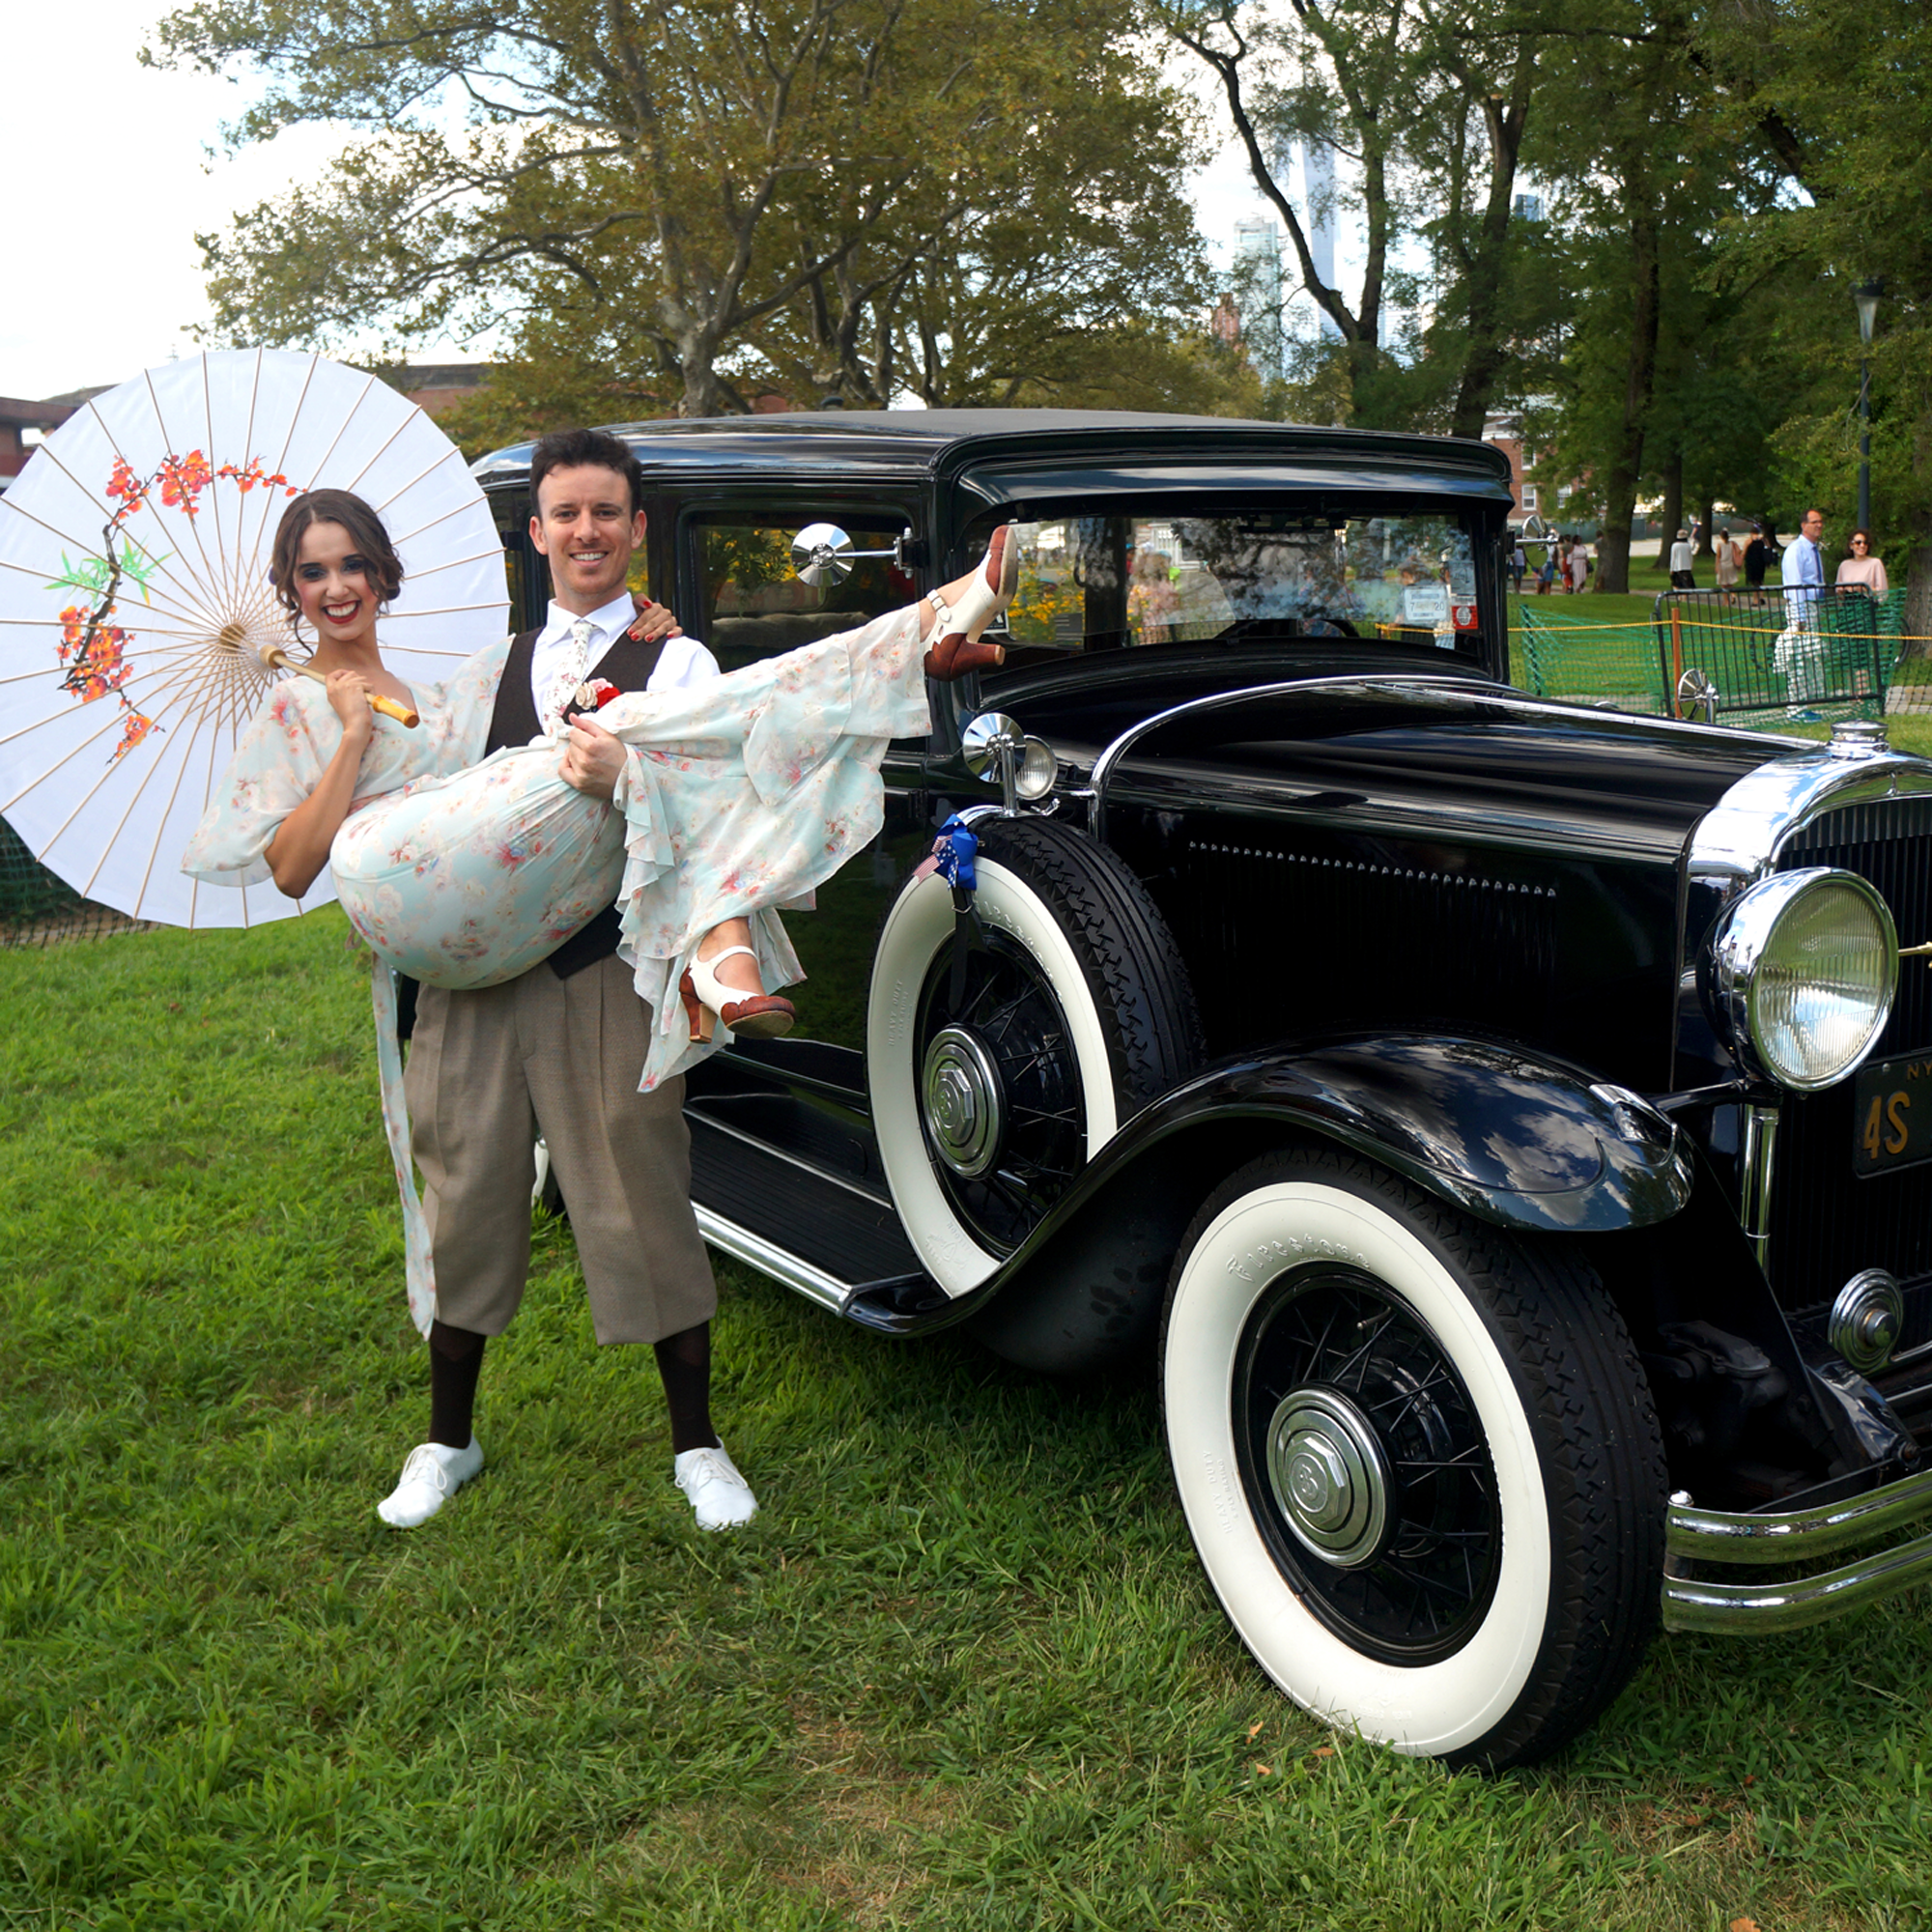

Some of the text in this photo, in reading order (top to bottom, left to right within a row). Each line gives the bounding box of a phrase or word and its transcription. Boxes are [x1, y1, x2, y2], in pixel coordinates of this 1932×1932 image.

[1906, 1060, 1932, 1081] NY
[1862, 1091, 1911, 1159] 4S
[1203, 1450, 1233, 1534] HEAVY DUTY
